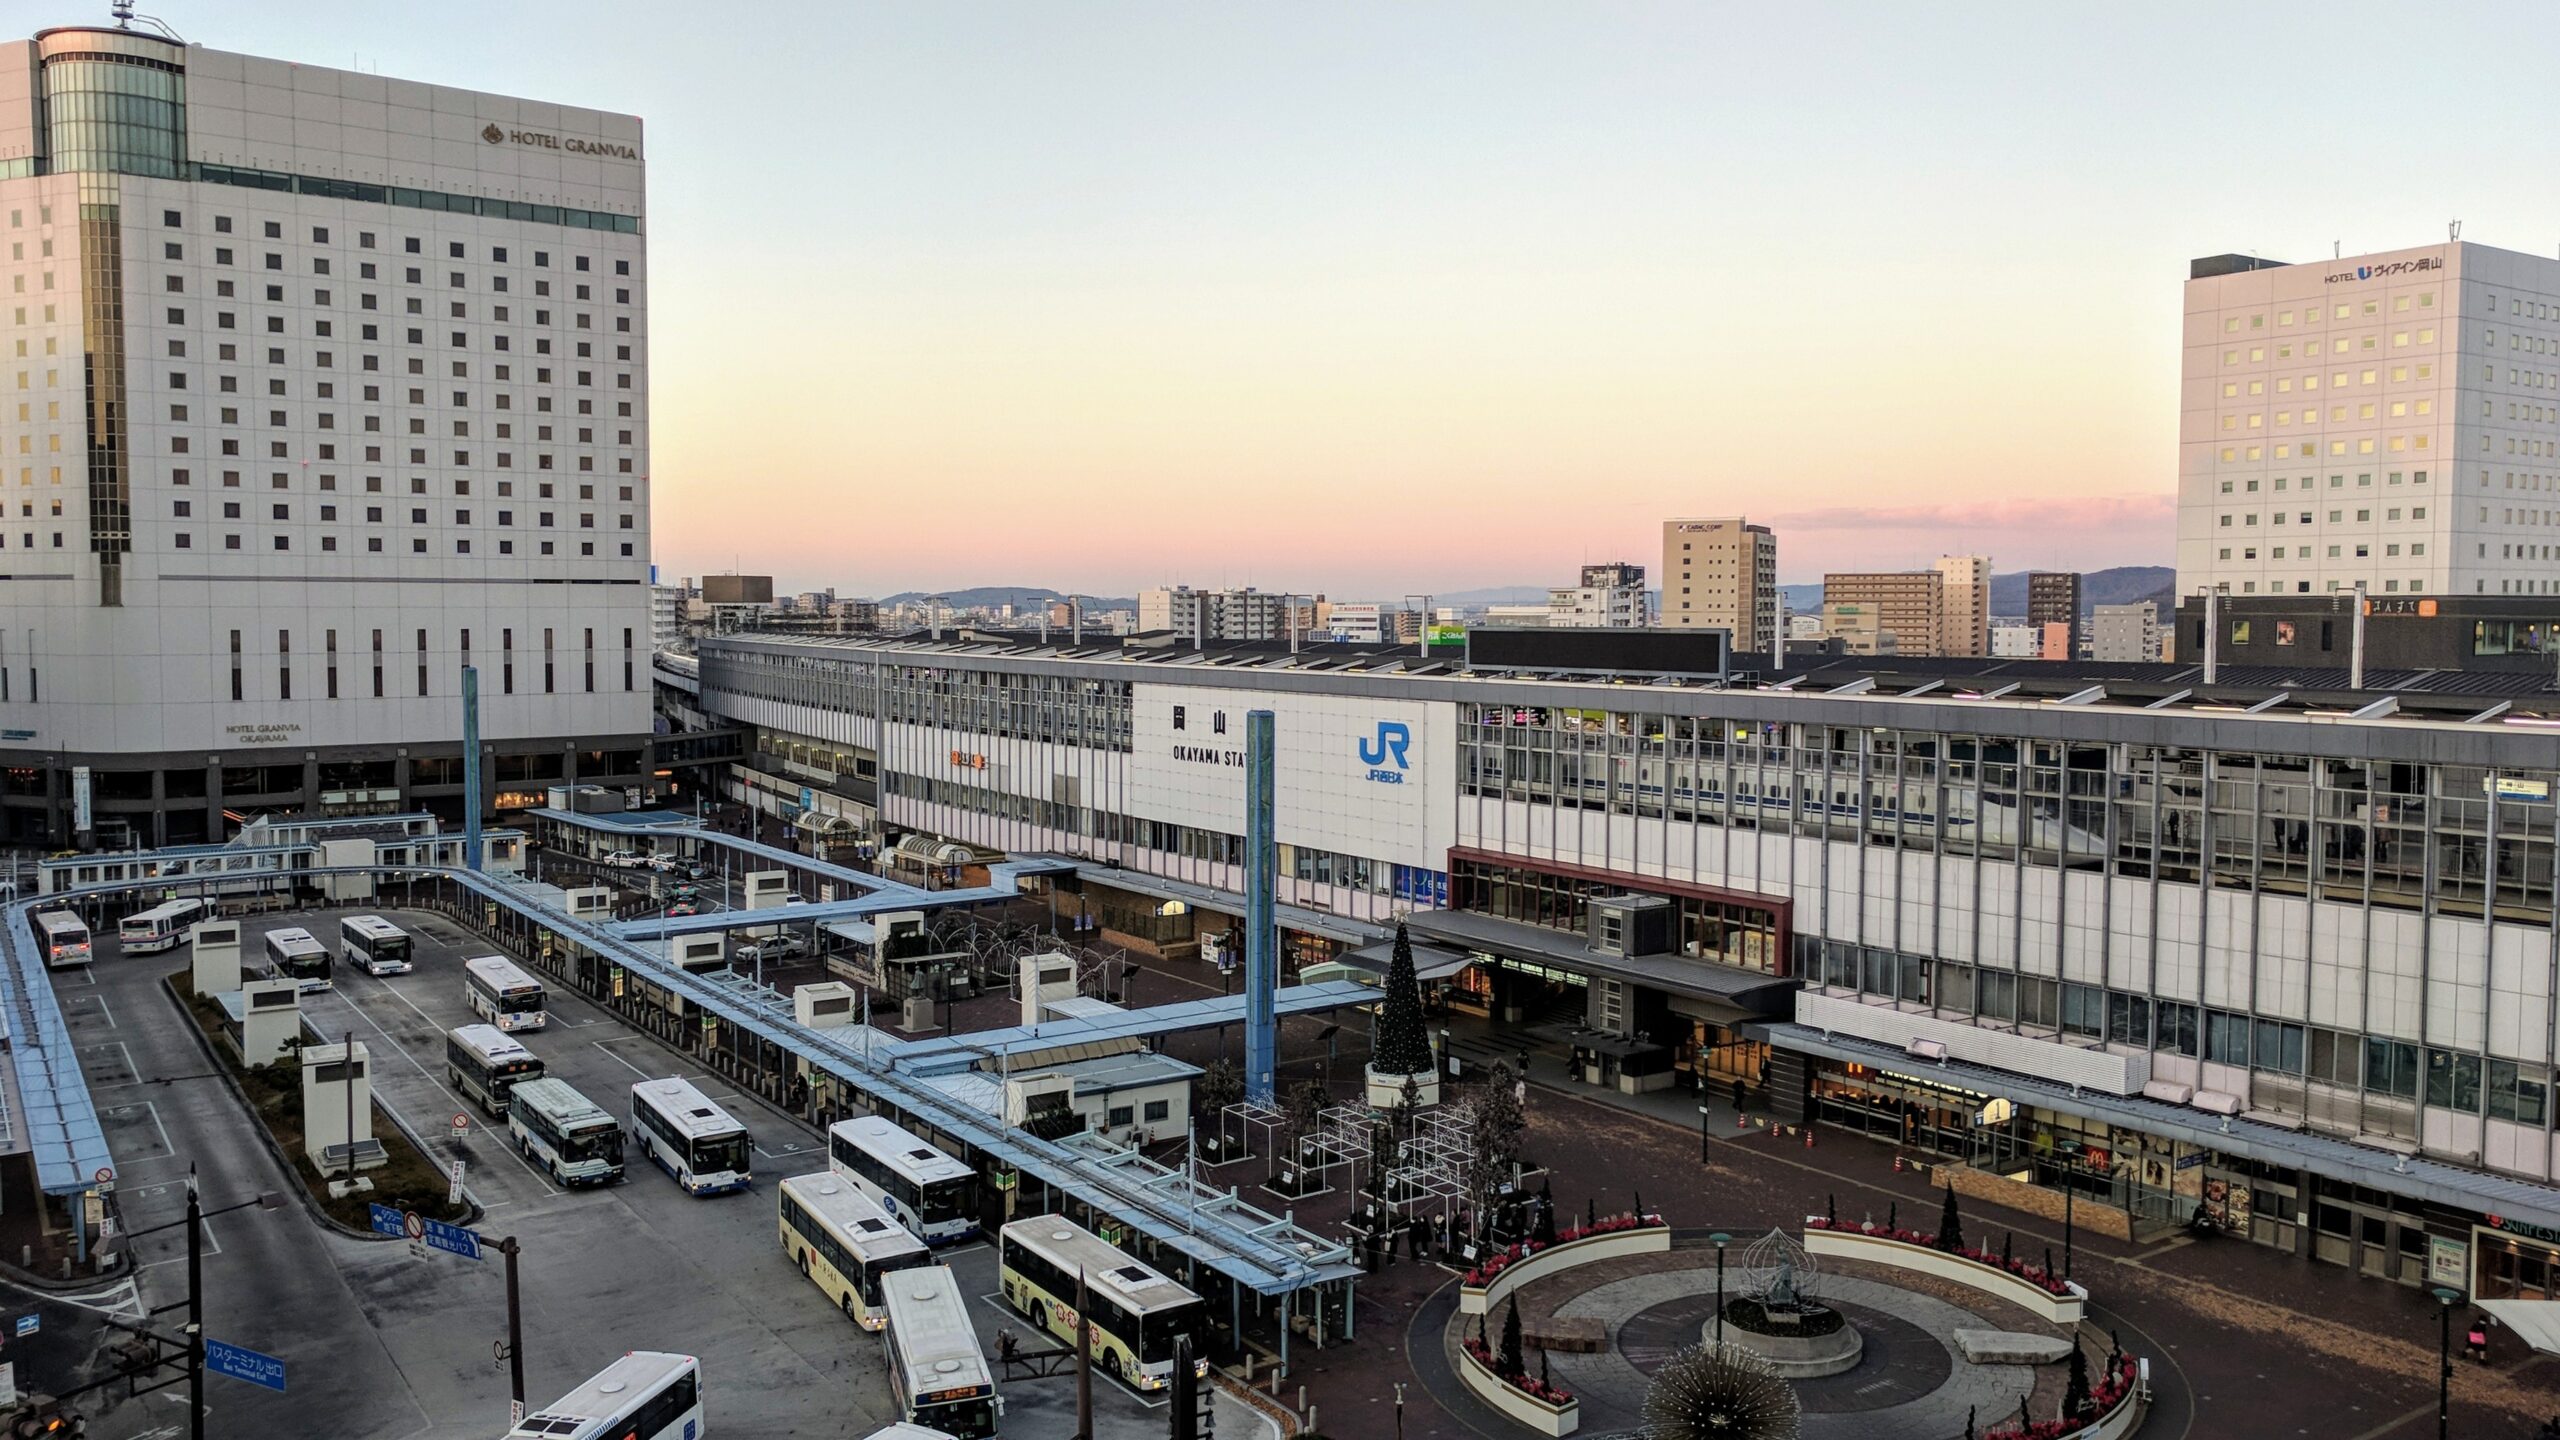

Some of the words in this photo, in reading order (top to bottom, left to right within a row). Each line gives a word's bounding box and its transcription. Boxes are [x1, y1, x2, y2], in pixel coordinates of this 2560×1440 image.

[510, 130, 560, 150] HOTEL
[564, 138, 637, 161] GRANVIA
[2374, 256, 2442, 277] ヴィアイン岡山
[2324, 272, 2356, 284] HOTEL
[226, 725, 255, 734] HOTEL
[257, 723, 301, 733] GRANVIA
[1173, 745, 1220, 766] OKAYAMA
[1359, 721, 1410, 769] JR
[1365, 768, 1404, 784] JR西日本
[208, 1344, 283, 1378] バスターミナル出口
